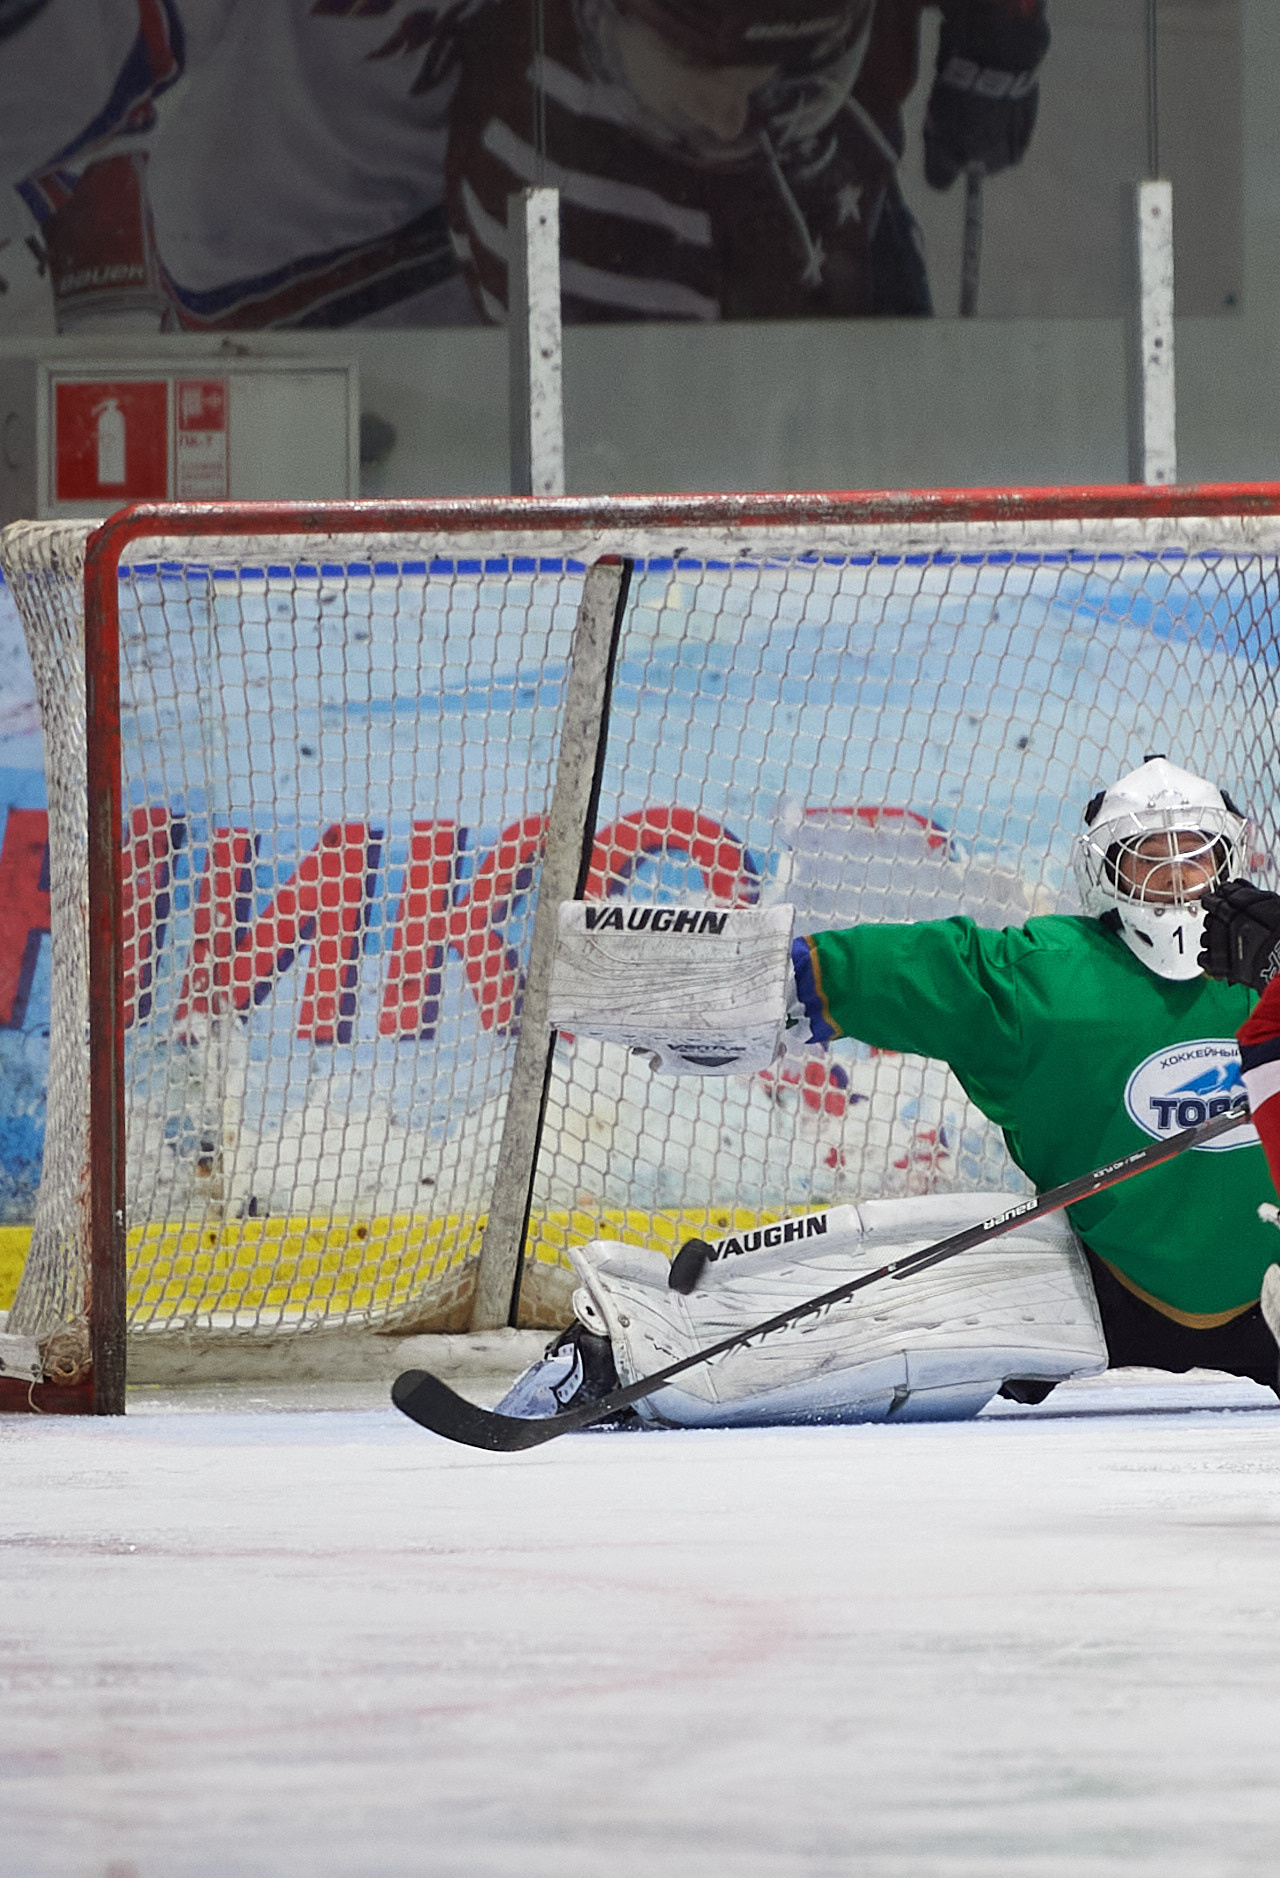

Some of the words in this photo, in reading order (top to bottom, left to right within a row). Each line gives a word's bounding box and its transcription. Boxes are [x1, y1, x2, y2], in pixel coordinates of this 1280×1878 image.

[585, 906, 729, 936] VAUGHN
[1172, 925, 1184, 954] 1
[1149, 1092, 1249, 1130] ТОР
[983, 1198, 1039, 1231] BAUER
